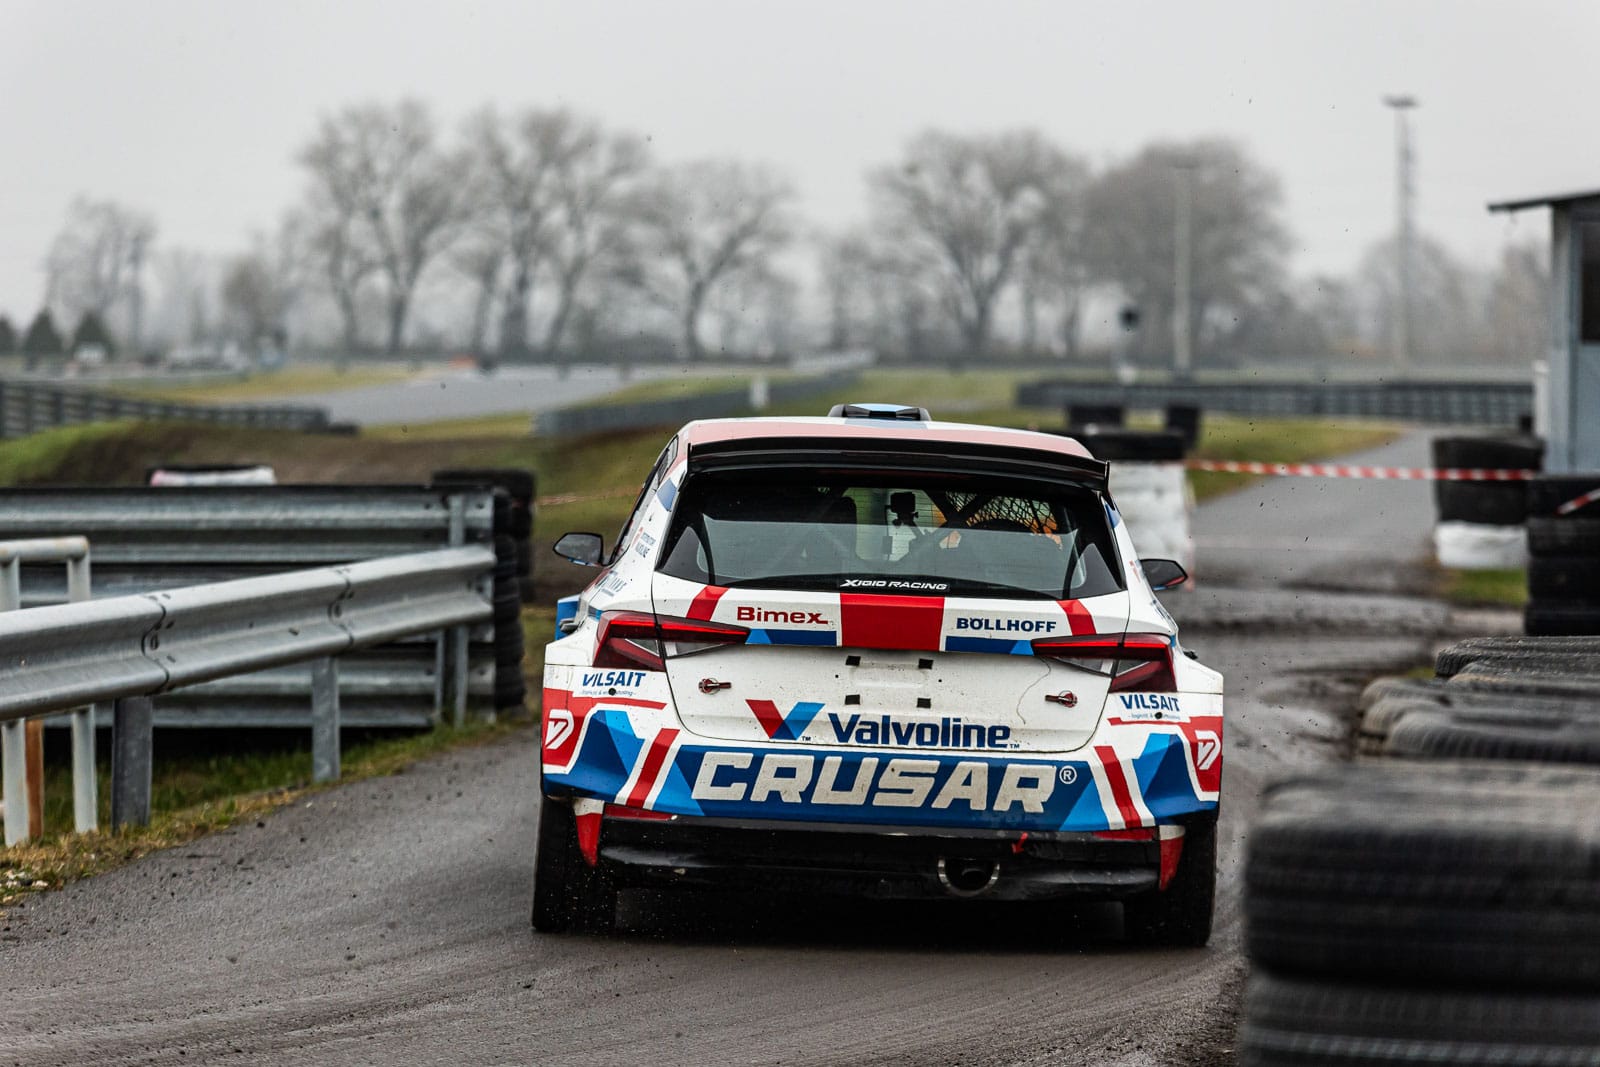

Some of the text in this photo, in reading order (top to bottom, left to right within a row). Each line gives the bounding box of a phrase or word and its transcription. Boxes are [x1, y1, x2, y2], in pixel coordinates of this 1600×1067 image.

[888, 581, 948, 590] RACING
[737, 606, 829, 625] Bimex
[956, 618, 1057, 633] BÖLLHOFF
[582, 671, 646, 687] VILSAIT
[1120, 694, 1180, 712] VILSAIT
[828, 712, 1011, 749] Valvoline
[691, 751, 1057, 813] CRUSAR
